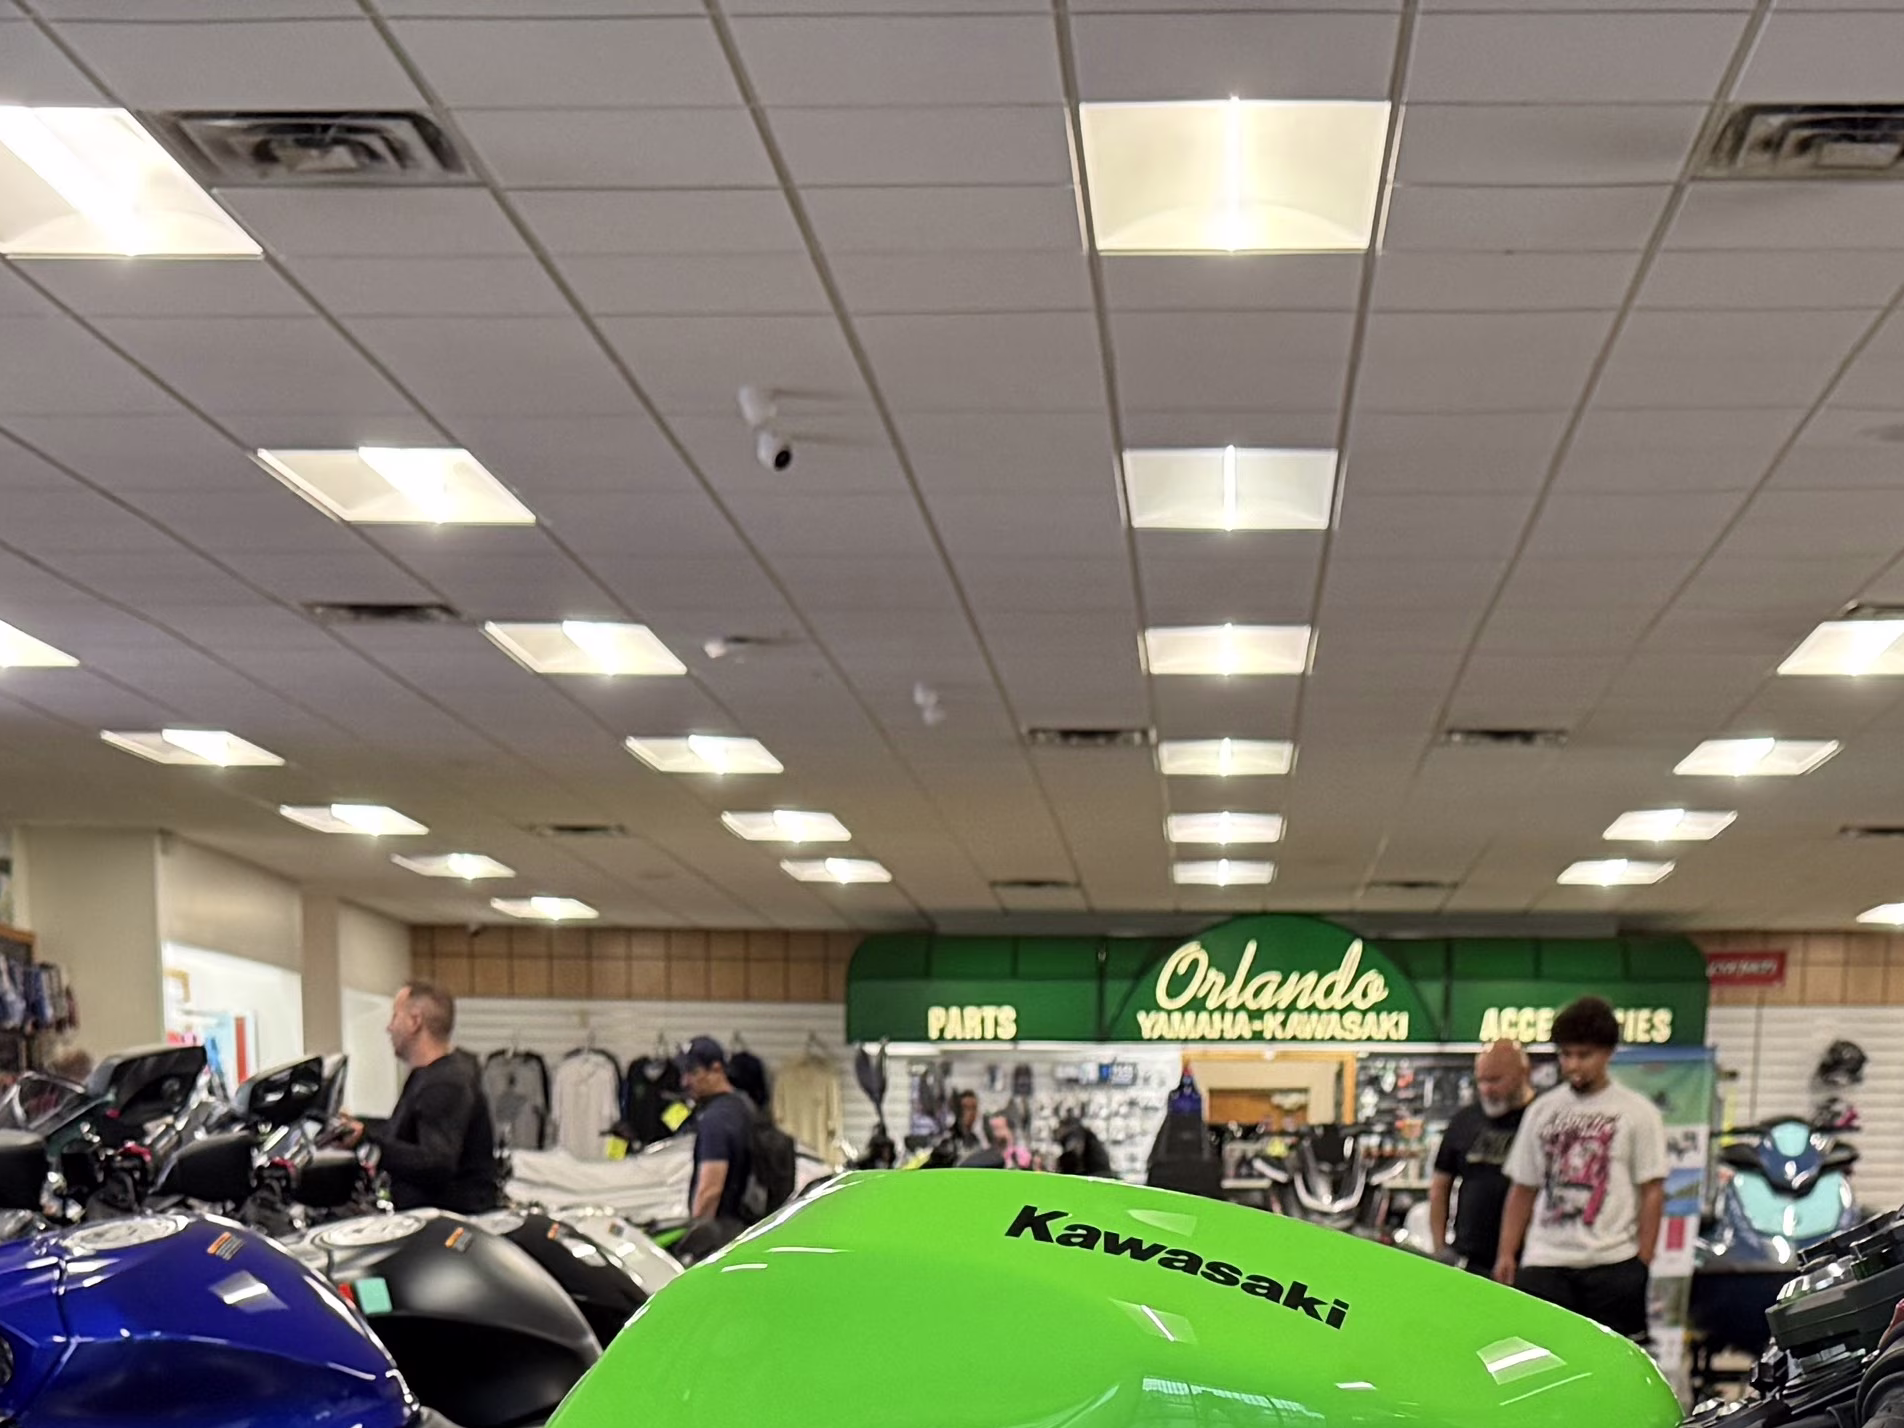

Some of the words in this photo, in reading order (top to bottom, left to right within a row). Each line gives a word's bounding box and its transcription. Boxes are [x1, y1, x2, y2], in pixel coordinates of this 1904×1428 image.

[1154, 938, 1390, 1011] Orlando
[927, 1005, 1017, 1041] PARTS
[1136, 1009, 1409, 1042] YAMAHA-KAWASAKI
[1479, 1006, 1673, 1044] ACCEIES
[1005, 1205, 1350, 1331] Kawasaki
